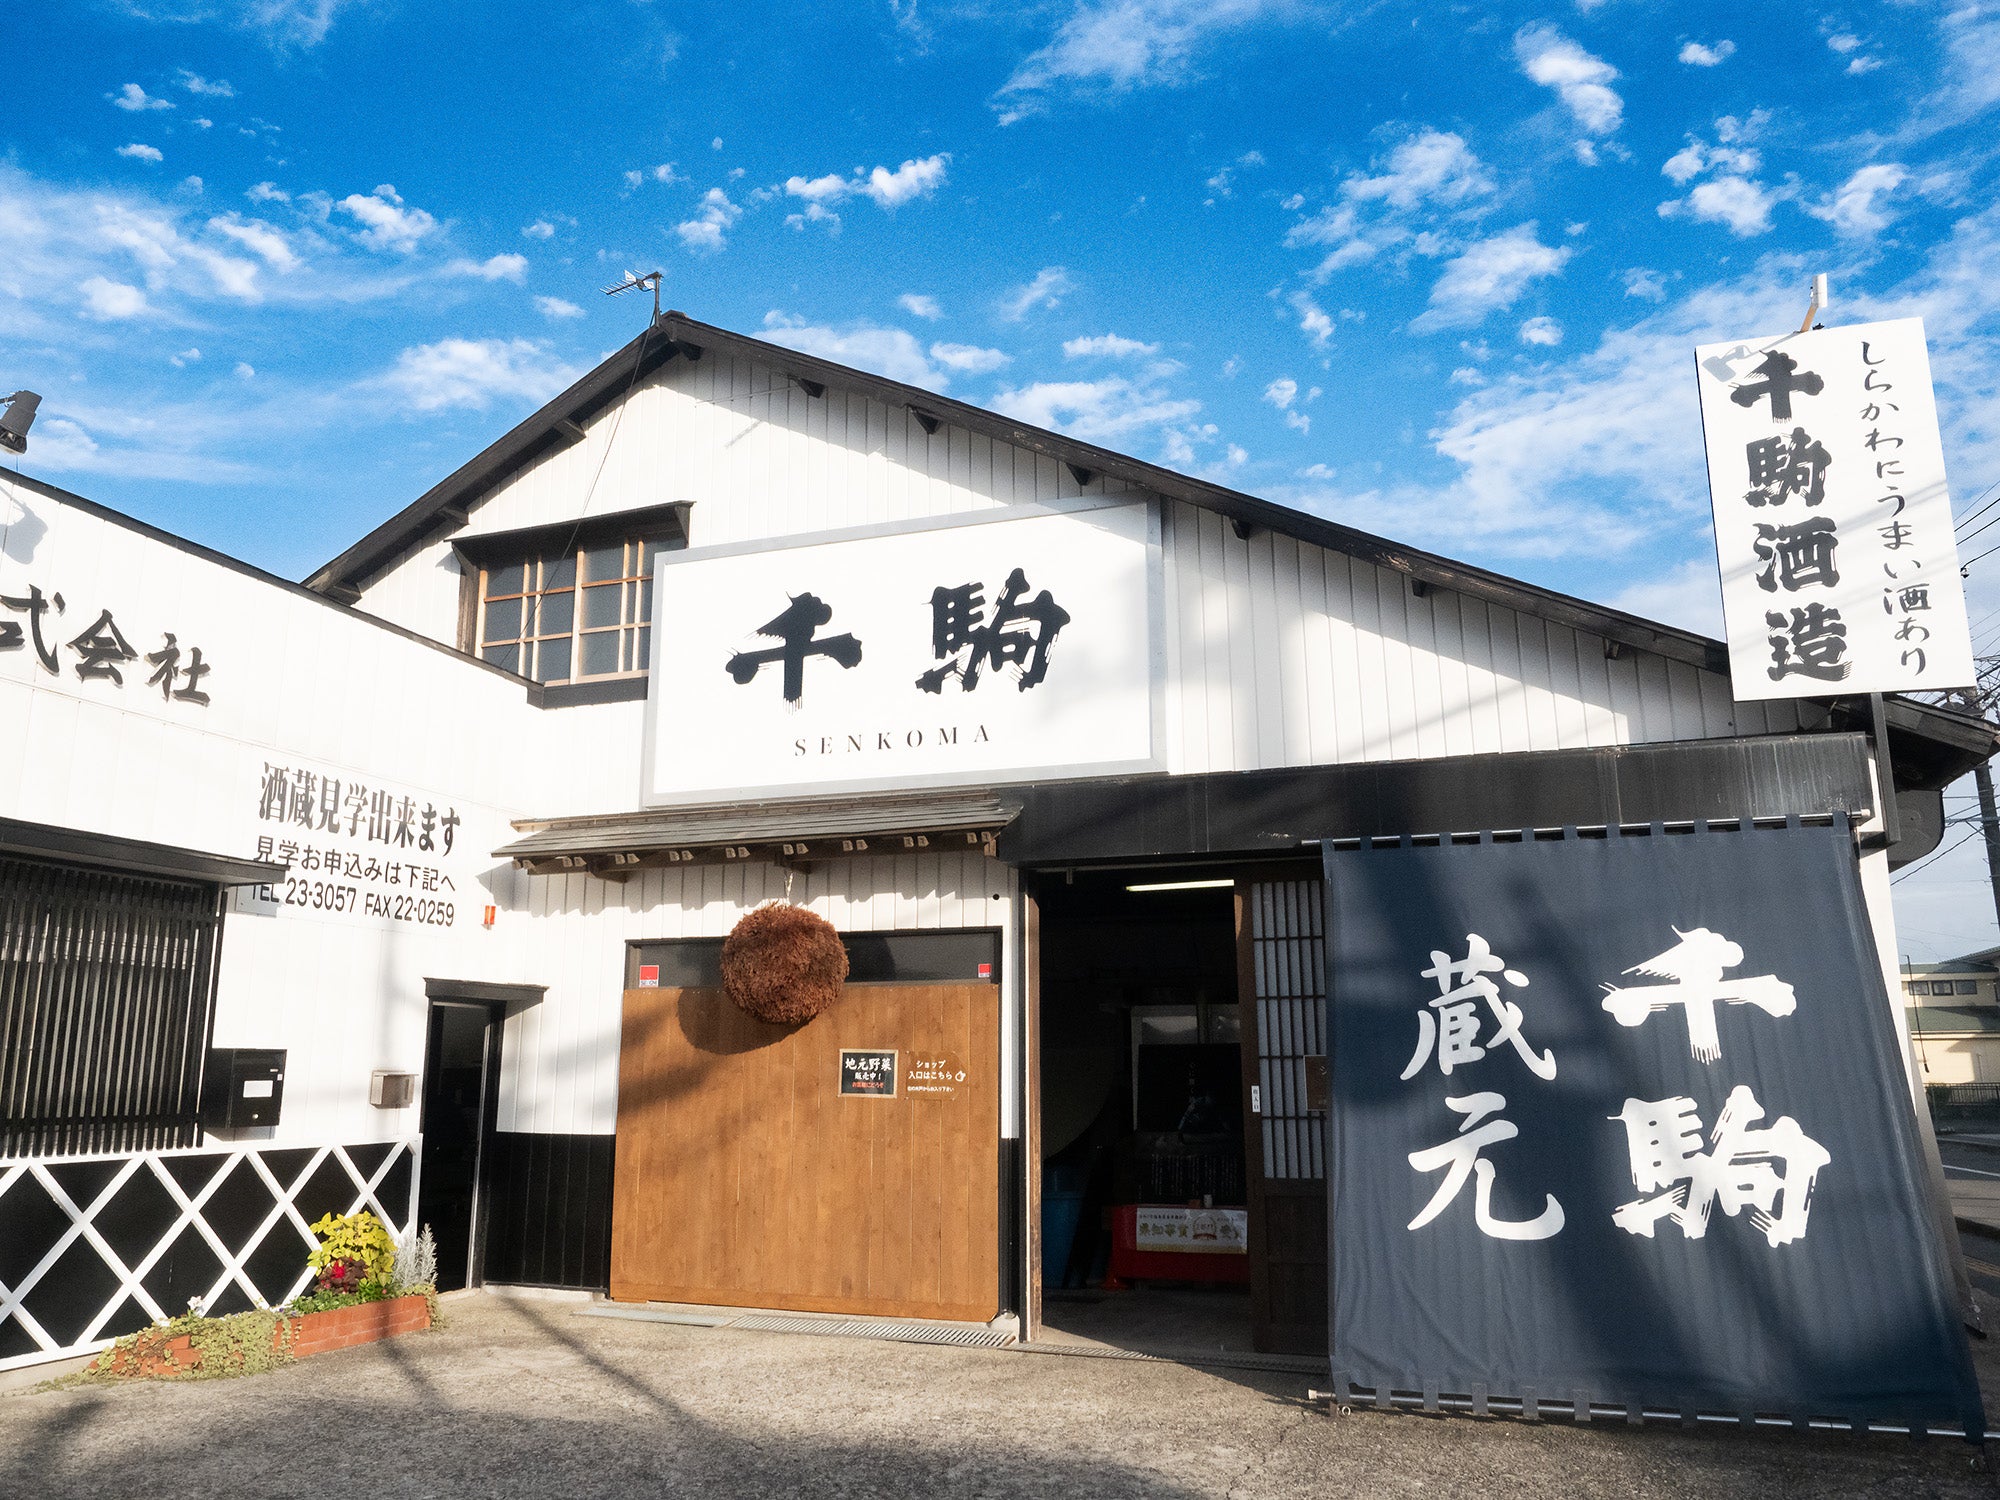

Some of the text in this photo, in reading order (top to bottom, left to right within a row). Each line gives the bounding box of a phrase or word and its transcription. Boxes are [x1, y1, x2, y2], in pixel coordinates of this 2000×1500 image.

[1730, 349, 1853, 682] 千駒酒造
[1858, 341, 1932, 676] しらかわにうまい酒あり
[724, 567, 1071, 715] 千駒
[794, 724, 989, 757] SENKOMA
[258, 761, 461, 857] 酒蔵見学出来ます
[254, 835, 456, 892] 見学お申込みは下記へ
[364, 893, 391, 919] FAX
[845, 1057, 892, 1072] 地元野菜
[908, 1070, 953, 1080] 入口はこちら
[916, 1059, 947, 1069] ショップ
[1400, 932, 1565, 1241] 蔵元
[1599, 925, 1832, 1248] 千駒
